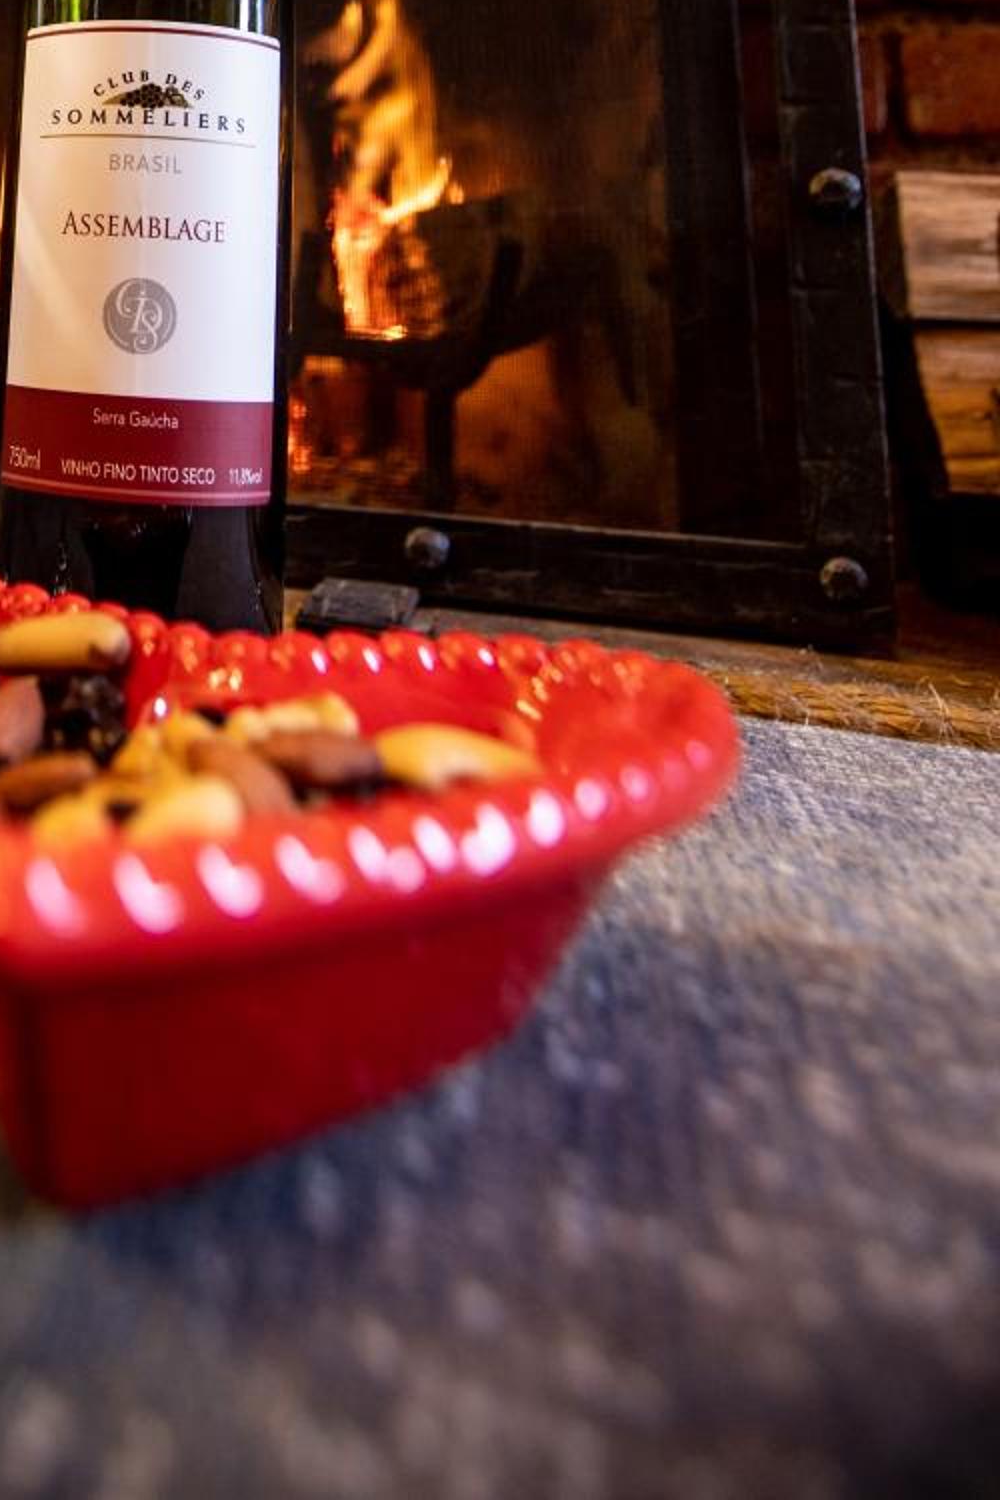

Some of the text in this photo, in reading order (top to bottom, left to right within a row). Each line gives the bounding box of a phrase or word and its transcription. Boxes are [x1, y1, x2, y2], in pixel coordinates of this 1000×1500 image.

[93, 69, 206, 101] CLUB DES
[51, 109, 246, 133] SOMMELIERS
[108, 153, 183, 175] BRASIL
[61, 210, 226, 244] ASSEMBLAGE
[93, 407, 179, 430] Serra Gaúcha
[8, 445, 41, 471] 750ml
[61, 459, 216, 485] VINHO FINO TINTO SECO
